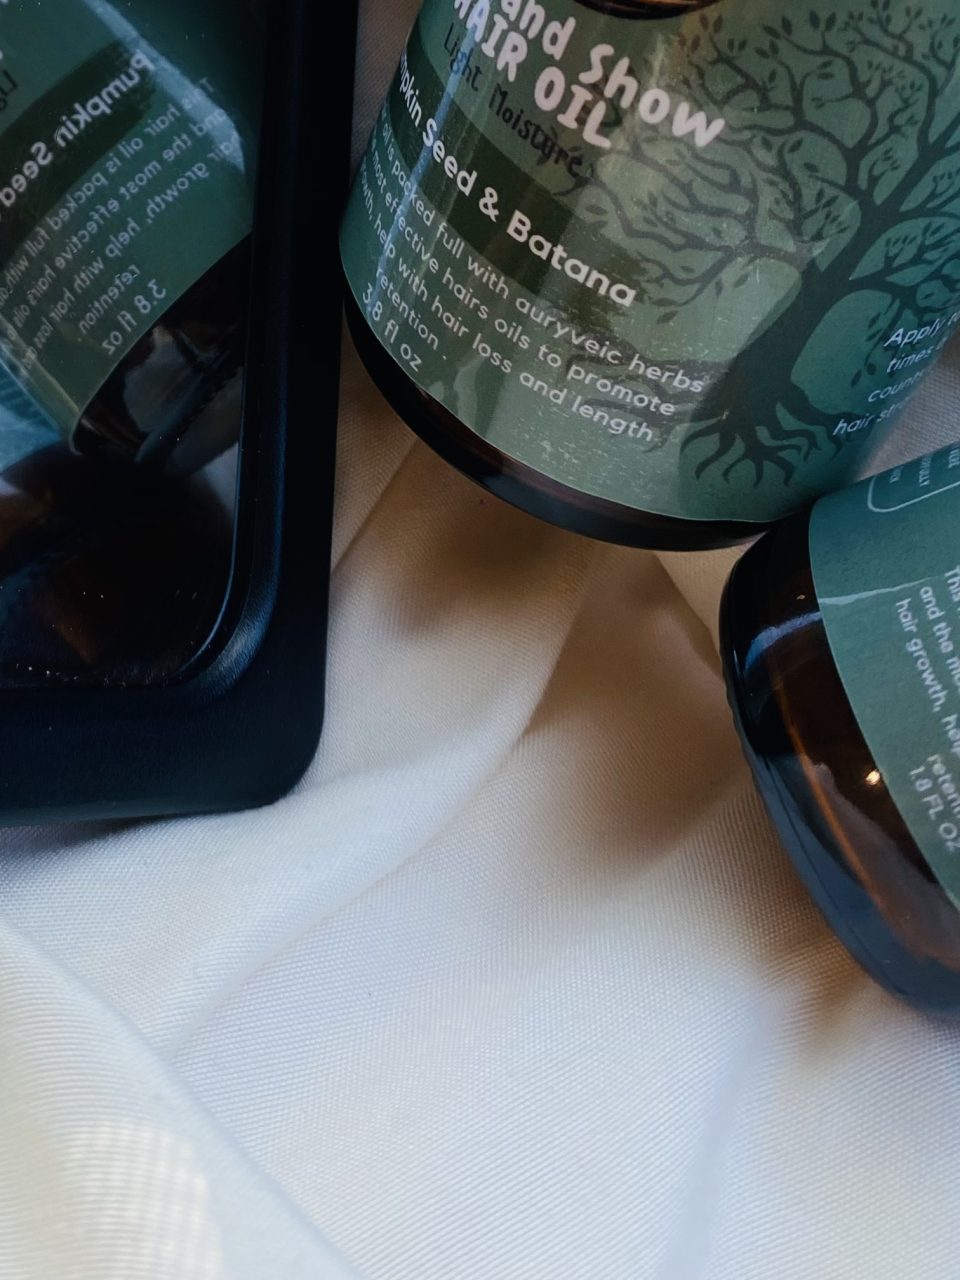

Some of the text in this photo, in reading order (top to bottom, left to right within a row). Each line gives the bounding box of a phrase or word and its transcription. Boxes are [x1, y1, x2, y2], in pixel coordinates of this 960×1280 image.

[444, 22, 483, 92] Light
[578, 42, 726, 151] Show
[533, 65, 612, 150] OIL
[400, 48, 637, 307] mpkin Seed & Batana
[376, 267, 439, 351] retention
[385, 191, 439, 274] effective
[442, 267, 489, 321] hairs
[494, 318, 531, 351] oils
[536, 342, 562, 368] to
[566, 362, 676, 417] promote
[391, 160, 436, 227] packed
[437, 221, 466, 258] full
[468, 255, 510, 300] with
[515, 296, 622, 366] auryveic
[628, 354, 705, 393] herbs
[383, 319, 400, 344] fl
[400, 343, 424, 373] oz
[398, 257, 429, 303] with
[431, 294, 471, 338] hair
[471, 331, 513, 375] loss
[519, 370, 567, 402] and
[571, 395, 653, 442] length
[831, 412, 877, 438] hair
[895, 596, 919, 634] hair
[919, 585, 947, 622] and
[932, 621, 955, 655] the
[905, 637, 950, 714] growth,
